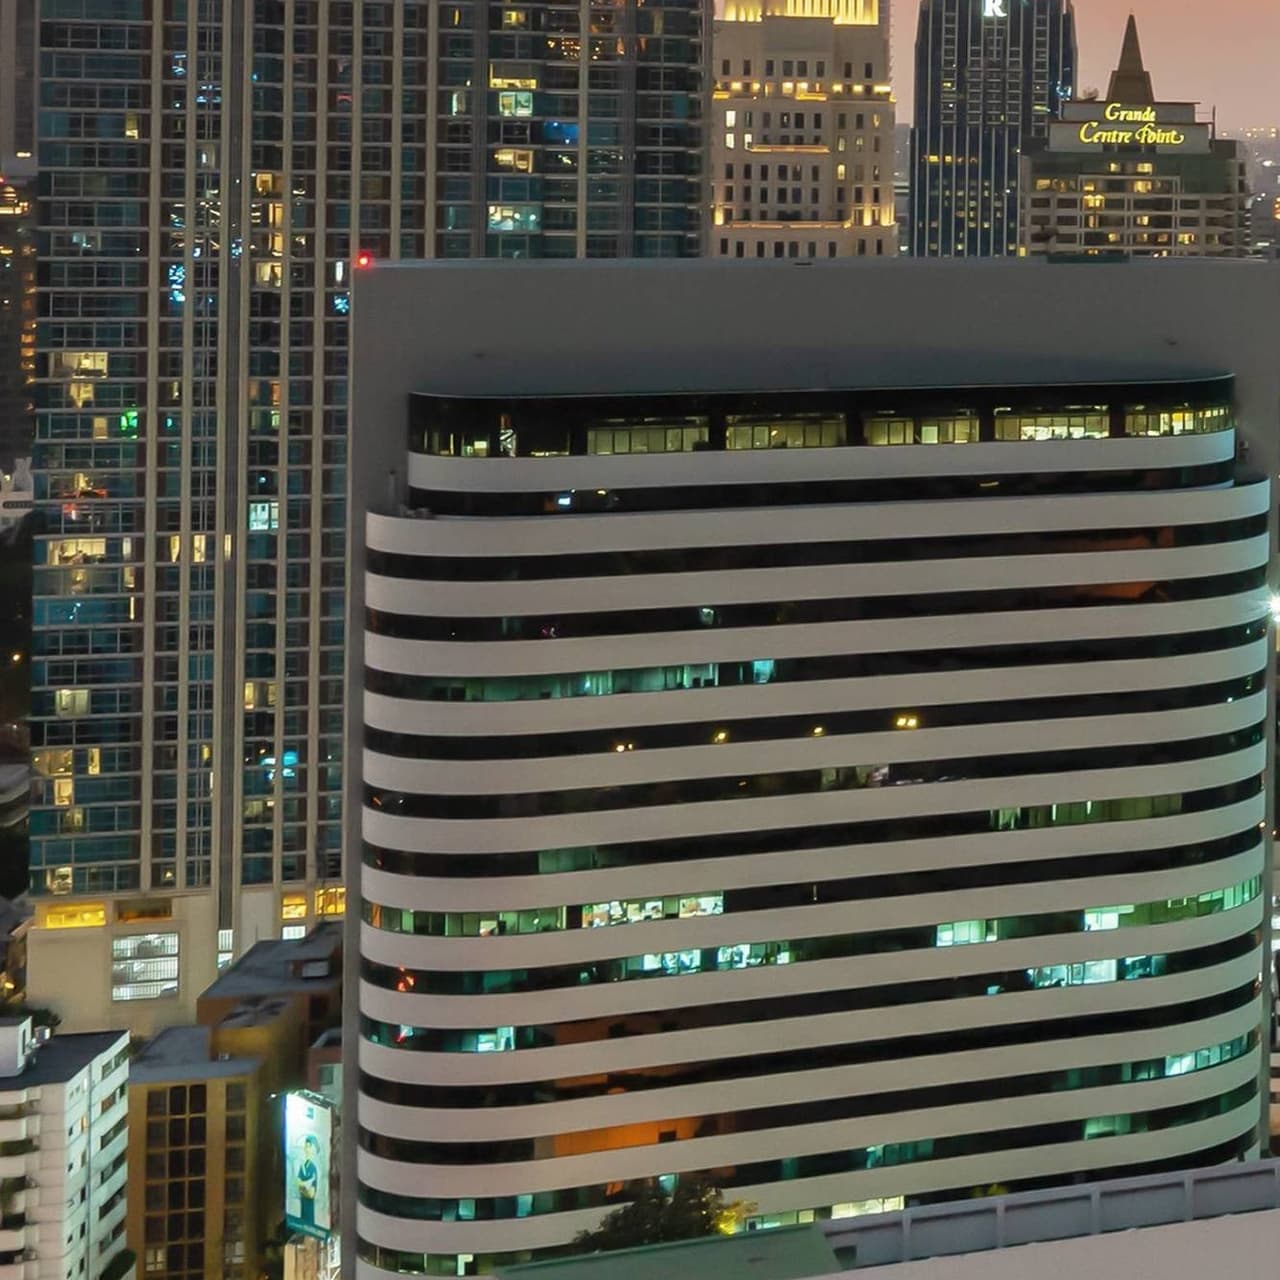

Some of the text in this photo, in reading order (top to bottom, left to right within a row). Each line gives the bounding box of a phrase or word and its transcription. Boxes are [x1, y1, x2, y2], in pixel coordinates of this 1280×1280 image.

[1104, 102, 1157, 122] Grande
[1078, 120, 1185, 145] Centre Point
